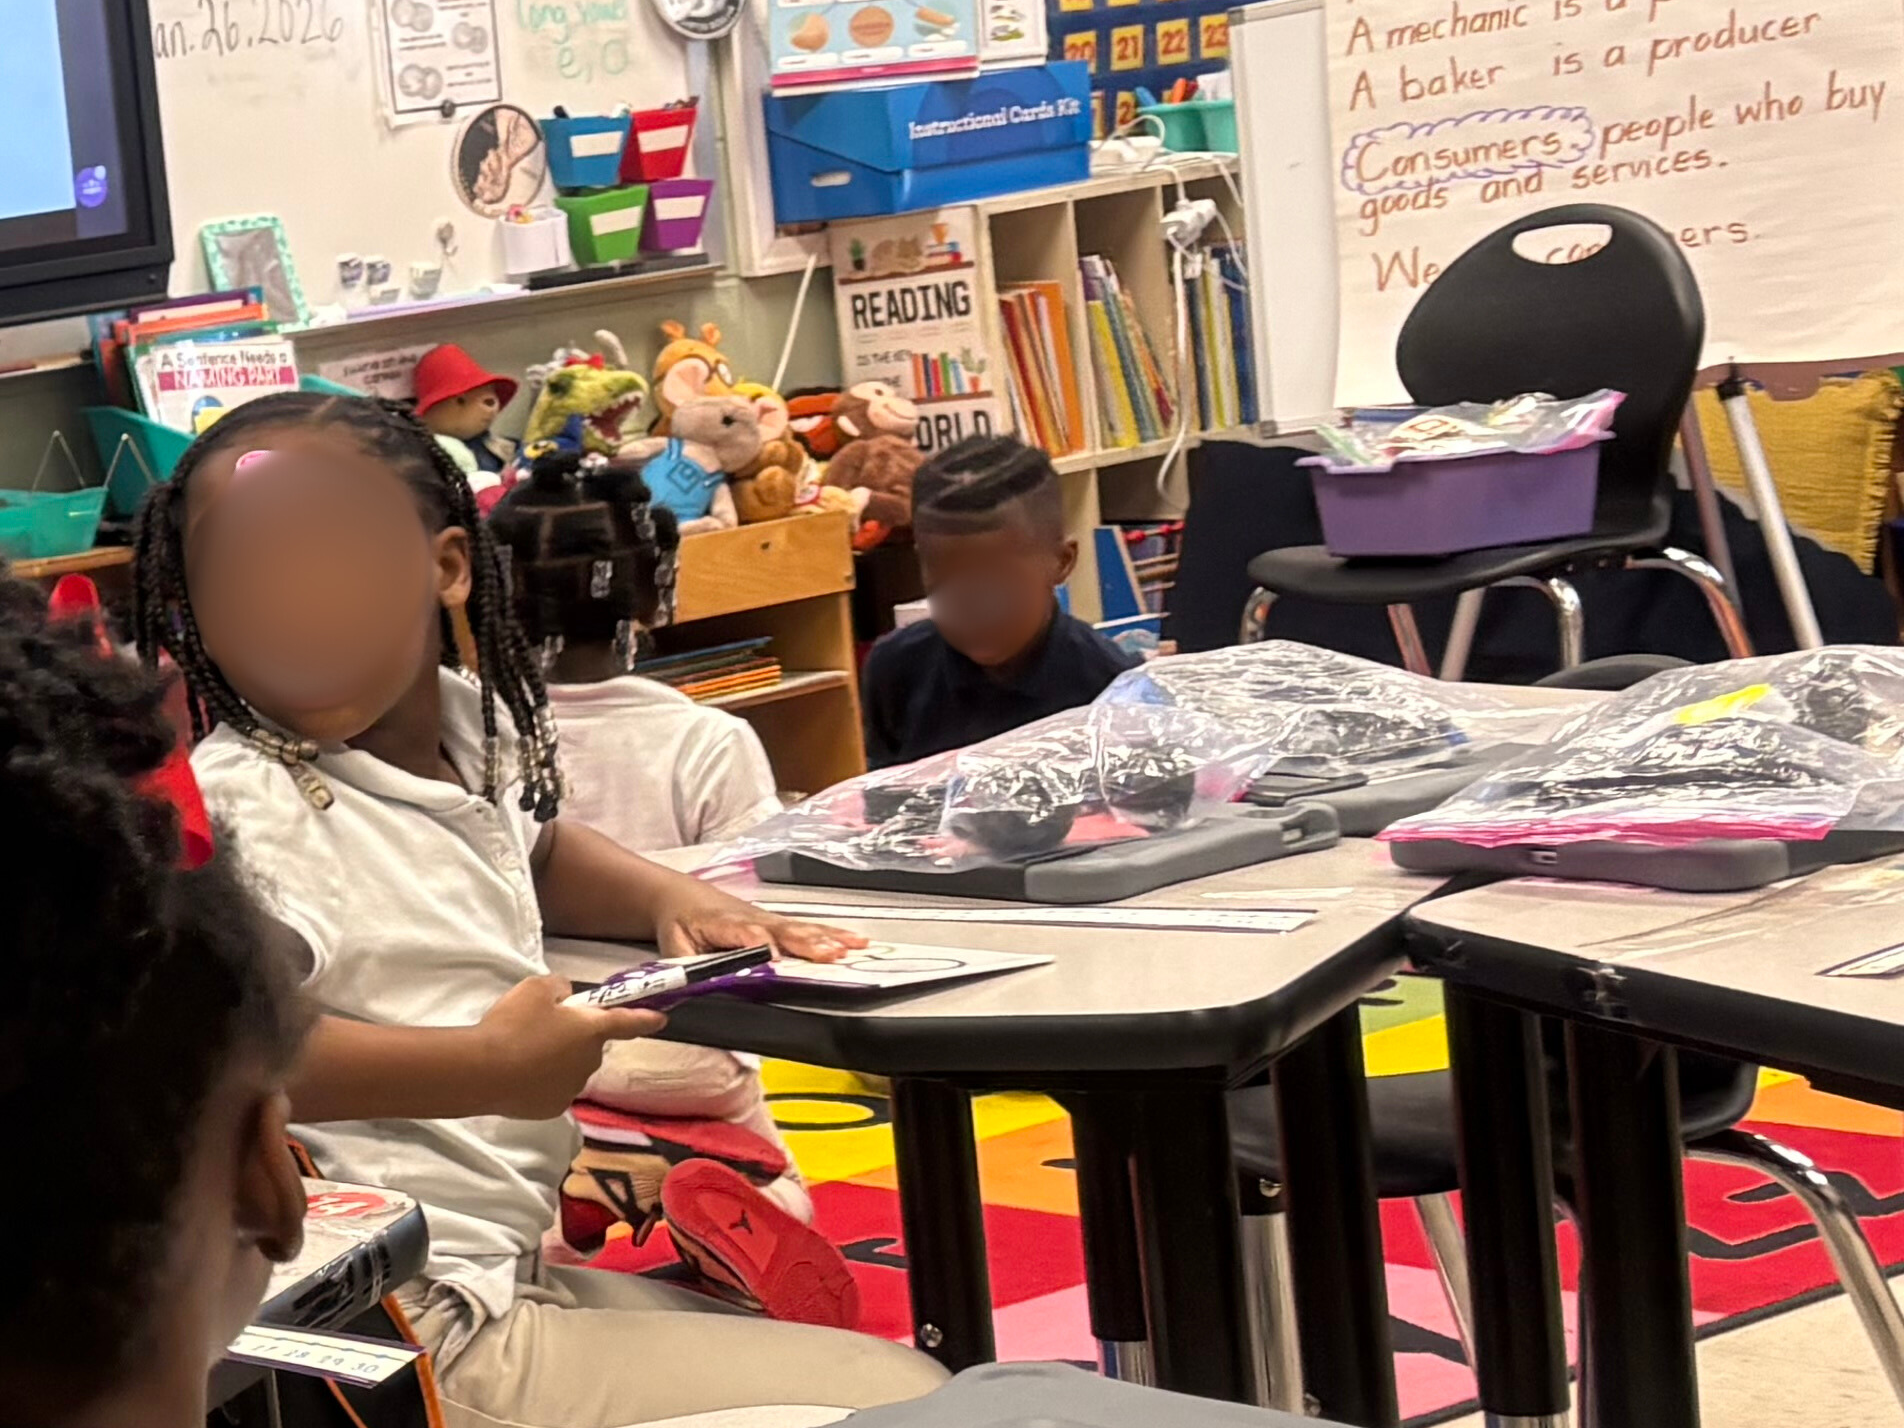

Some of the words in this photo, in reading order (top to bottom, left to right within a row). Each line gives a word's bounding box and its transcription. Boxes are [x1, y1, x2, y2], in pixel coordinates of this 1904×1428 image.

[1345, 17, 1374, 58] A
[1350, 68, 1376, 112] A
[1400, 56, 1506, 101] baker
[1552, 45, 1583, 76] is
[1603, 44, 1625, 67] a
[1647, 8, 1822, 76] producer
[909, 105, 1006, 141] Instructional
[1011, 103, 1055, 127] Cards
[1058, 98, 1082, 120] Kit
[1599, 97, 1716, 155] people
[1735, 80, 1804, 122] who
[1825, 68, 1887, 121] buy
[1359, 174, 1447, 237] goods
[1479, 164, 1545, 205] and
[1373, 245, 1441, 292] We
[852, 278, 971, 330] READING
